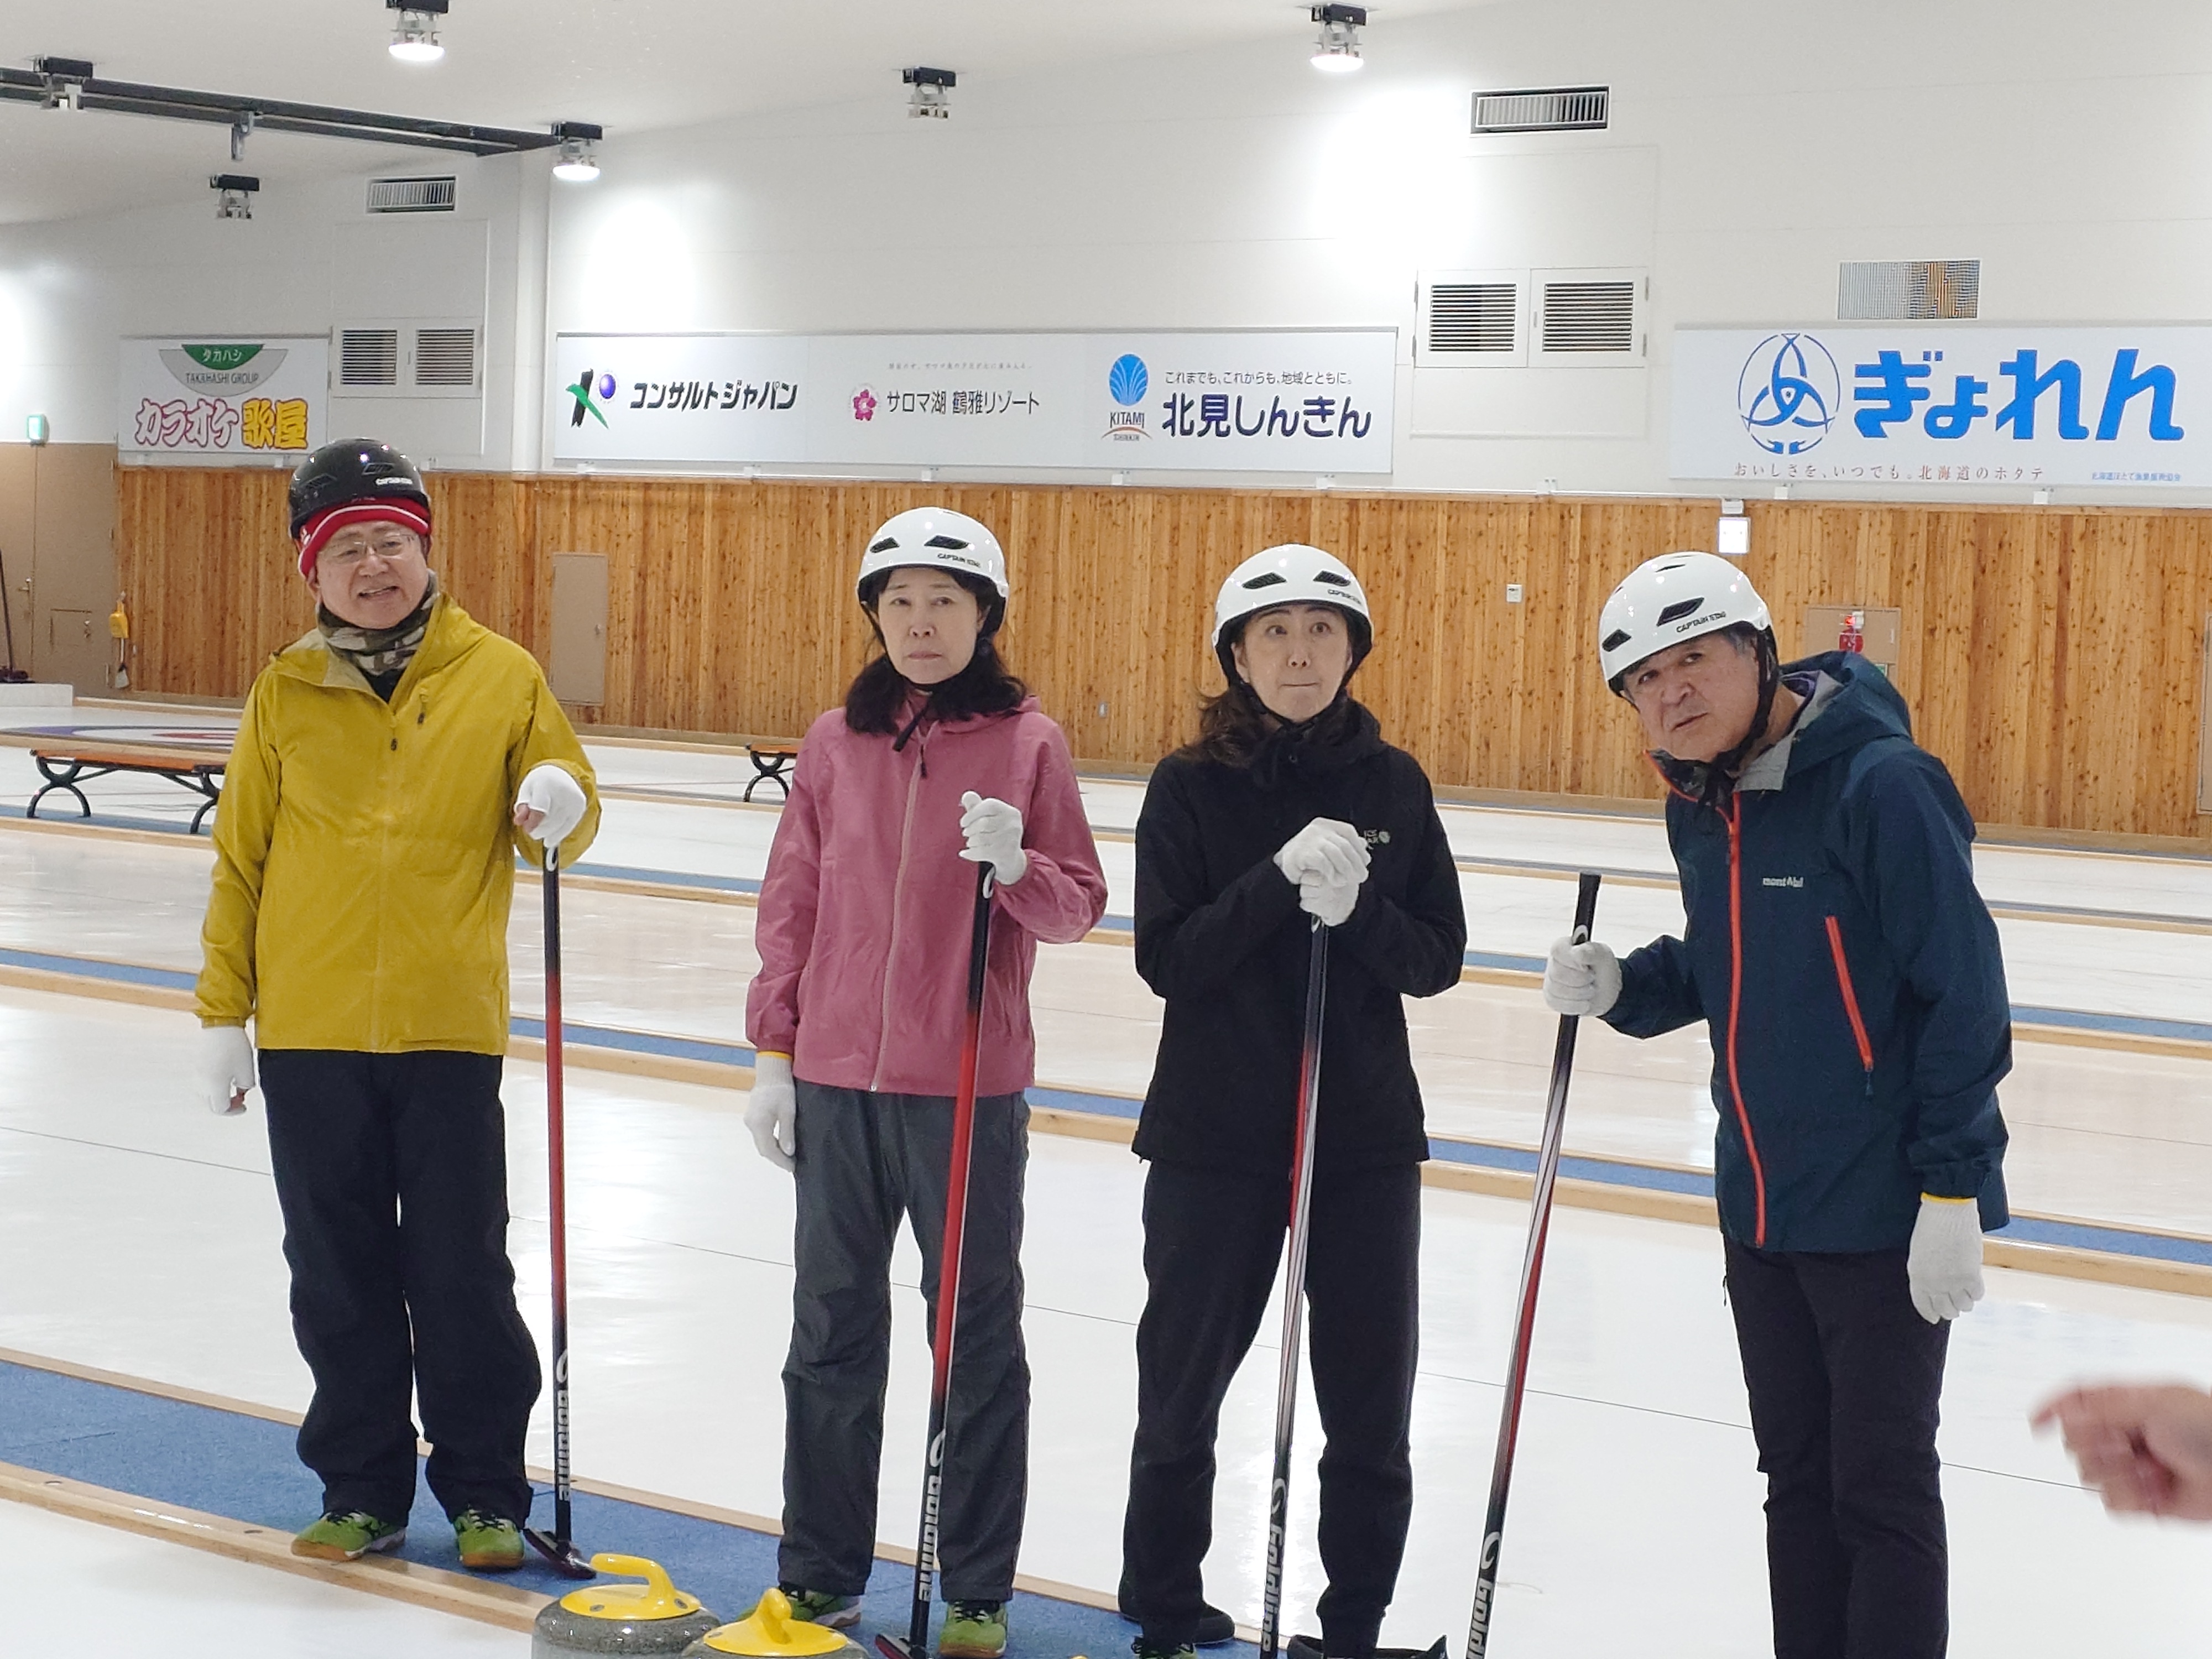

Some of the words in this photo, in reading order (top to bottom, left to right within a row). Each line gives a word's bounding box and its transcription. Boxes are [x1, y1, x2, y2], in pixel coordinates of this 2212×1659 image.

[202, 349, 242, 363] タカハシ
[186, 373, 229, 384] TAKAHASHI
[231, 373, 259, 384] GROUP
[630, 380, 799, 411] コンサルトジャパン
[887, 389, 946, 415] サロマ湖
[952, 389, 1039, 415] 鶴雅リゾート
[1854, 348, 2184, 441] ぎょれん
[1110, 411, 1144, 429] KITAMI
[1162, 392, 1371, 438] 北見しんきん
